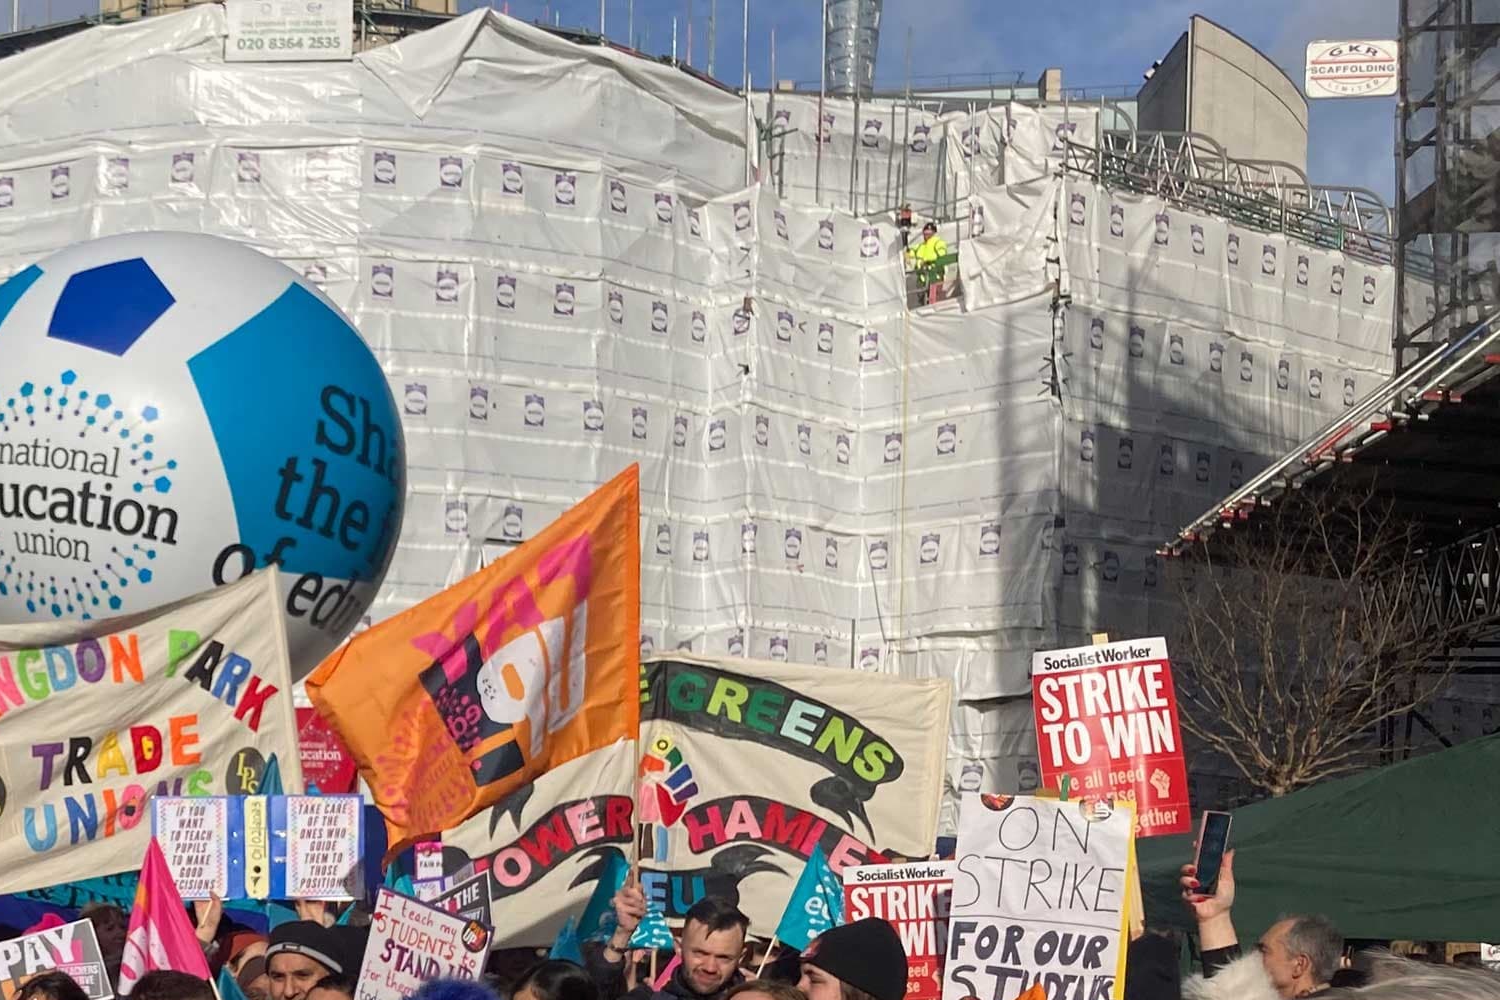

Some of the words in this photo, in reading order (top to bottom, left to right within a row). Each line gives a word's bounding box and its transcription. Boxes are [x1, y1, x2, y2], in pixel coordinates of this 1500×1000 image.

[1311, 64, 1395, 74] SCAFFOLDING
[275, 456, 370, 550] the
[15, 528, 91, 562] union
[164, 629, 279, 733] PARK
[1039, 664, 1168, 721] STRIKE
[667, 672, 894, 782] GREENS
[1043, 721, 1091, 767] TO
[1100, 709, 1175, 759] WIN
[32, 714, 202, 791] TRADE
[1085, 770, 1103, 788] all
[1109, 766, 1144, 786] need
[176, 807, 185, 816] IF
[188, 806, 206, 817] YOU
[299, 804, 321, 815] TAKE
[324, 803, 347, 814] CARE
[179, 818, 204, 828] WANT
[307, 816, 319, 826] OF
[322, 816, 338, 826] THE
[999, 806, 1090, 854] ON
[1134, 808, 1178, 832] gether
[170, 831, 182, 841] TO
[185, 830, 213, 841] TEACH
[300, 828, 324, 839] ONES
[327, 828, 347, 838] WHO
[474, 798, 633, 887] OWER
[684, 800, 891, 877] HAMLE
[175, 843, 207, 853] PUPILS
[309, 841, 336, 851] GUIDE
[172, 855, 184, 866] TO
[186, 855, 212, 865] MAKE
[304, 853, 330, 864] THEM
[332, 853, 343, 863] TO
[179, 867, 203, 878] GOOD
[310, 865, 338, 876] THOSE
[857, 870, 904, 881] Socialist
[905, 868, 945, 880] Worker
[175, 879, 216, 890] CISIONS
[300, 878, 348, 889] POSITIONS
[955, 854, 1124, 913] STRIKE
[851, 884, 952, 921] STRIKE
[379, 892, 395, 911] I
[402, 903, 434, 927] teach
[440, 922, 457, 945] my
[376, 913, 456, 960] STUDENTS
[461, 952, 477, 969] to
[951, 921, 1025, 965] FOR
[1034, 930, 1109, 969] OUR
[363, 960, 381, 981] for
[380, 938, 441, 982] STAND
[908, 962, 928, 977] eed
